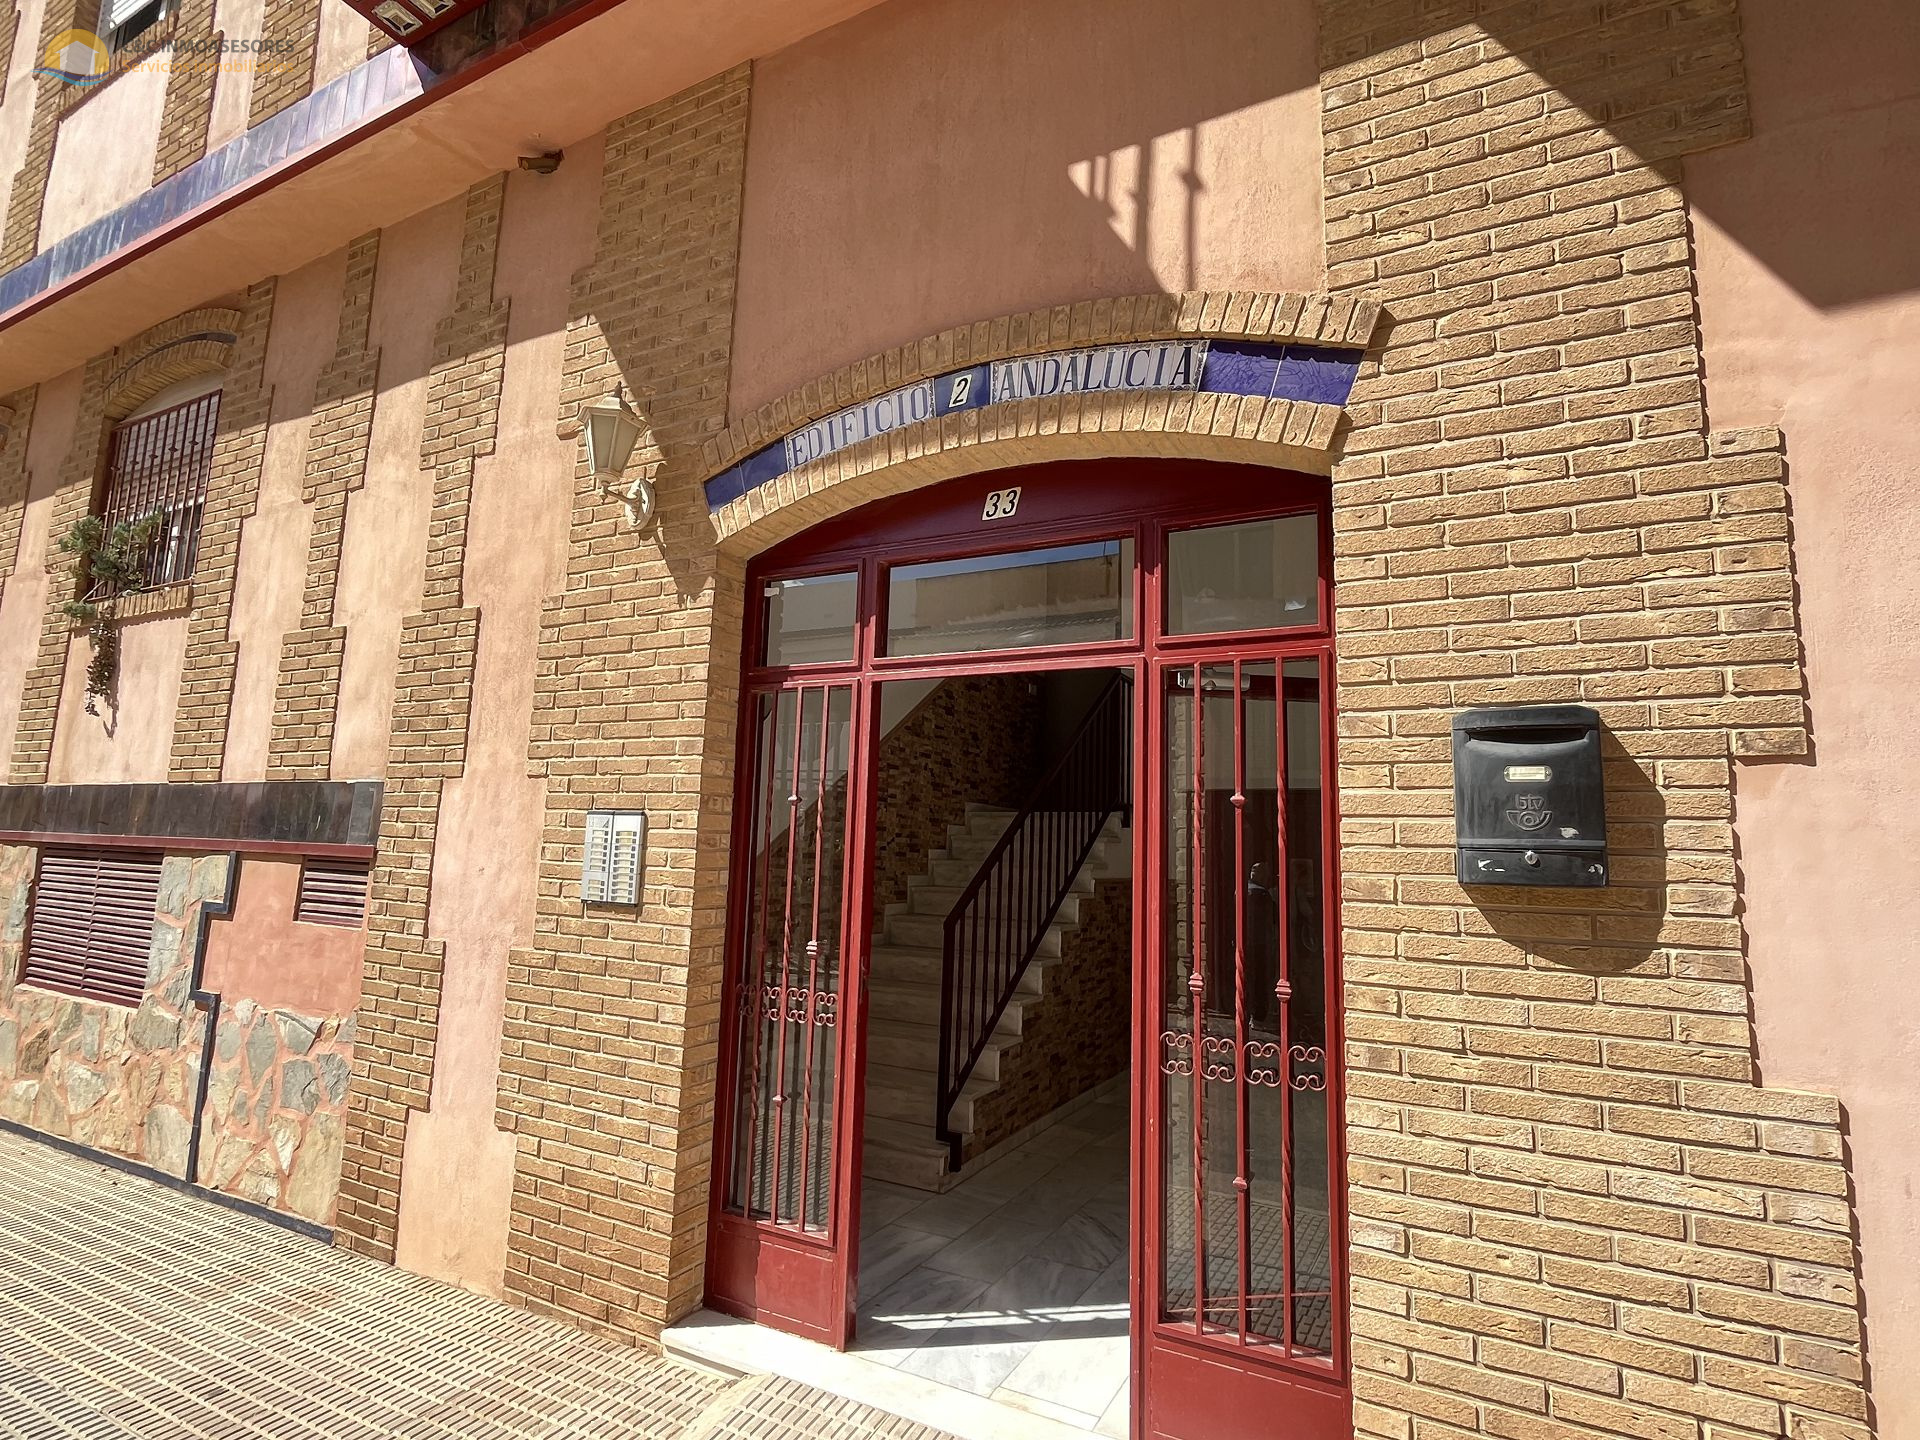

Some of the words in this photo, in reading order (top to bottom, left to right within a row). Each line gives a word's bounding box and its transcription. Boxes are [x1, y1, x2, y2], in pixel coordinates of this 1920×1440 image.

[790, 386, 929, 467] EDIFICIO
[950, 377, 970, 406] 2
[999, 345, 1193, 400] ANDALUCIA
[985, 489, 1018, 518] 33
[1515, 793, 1545, 810] btv
